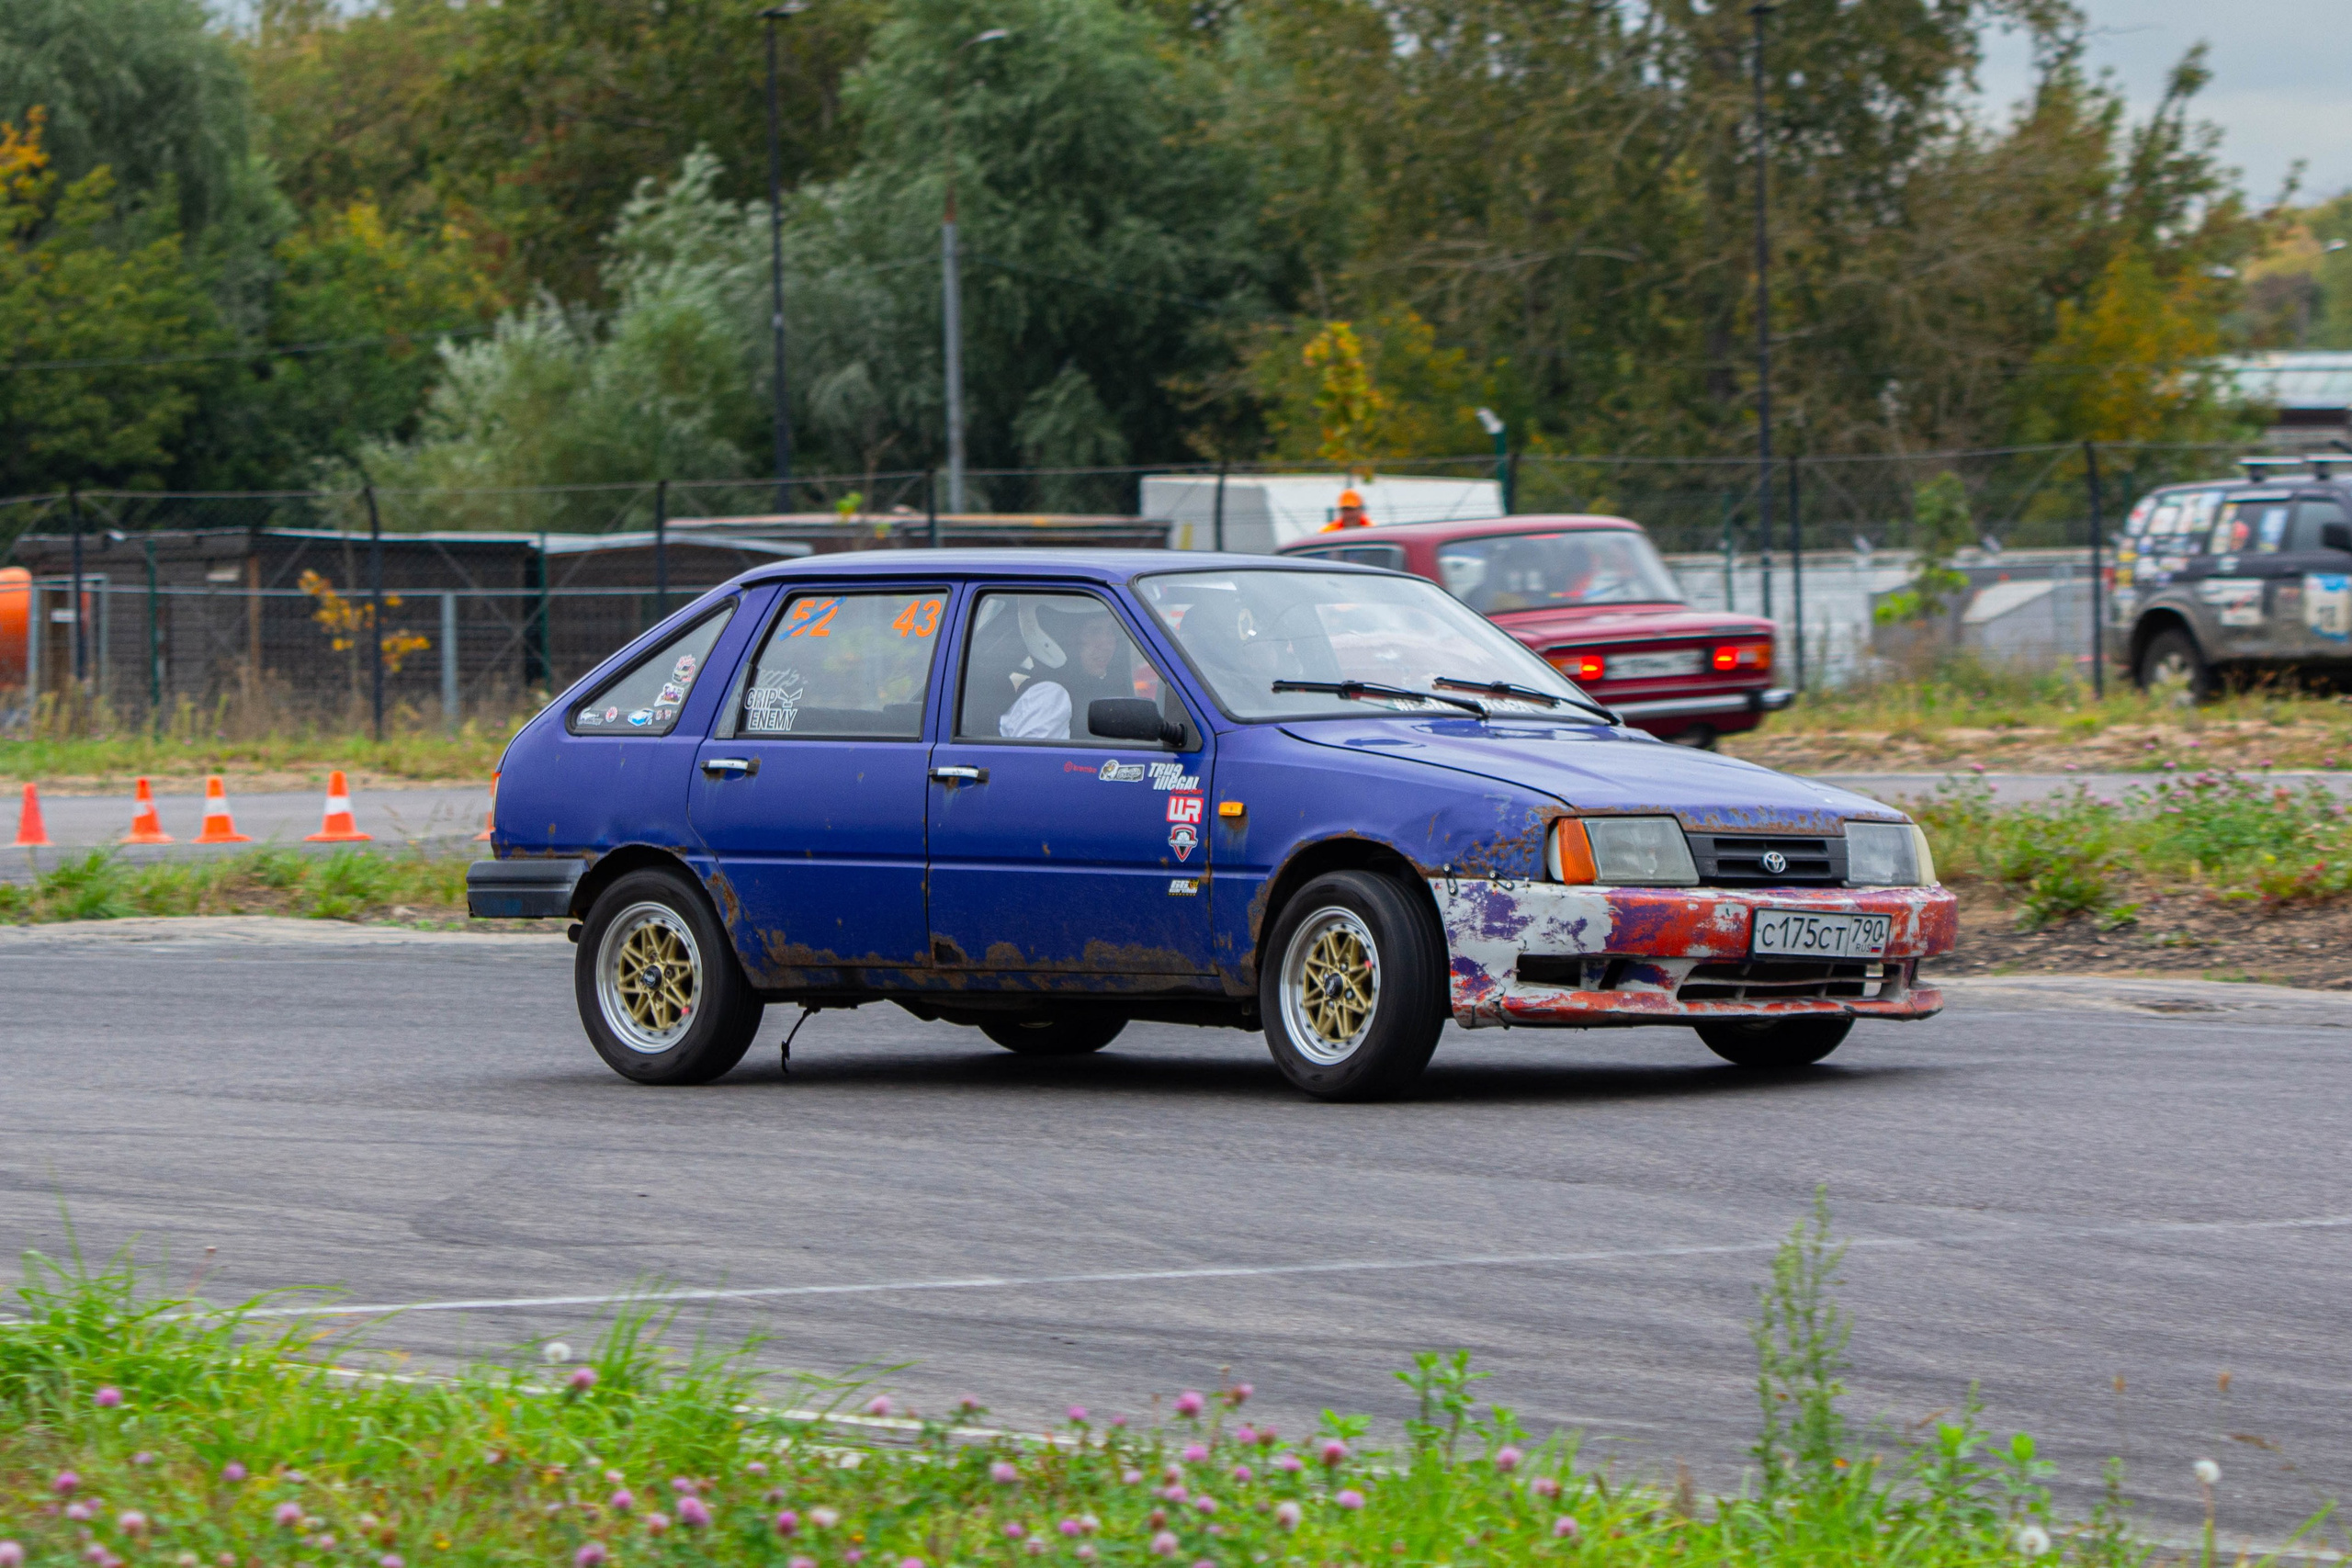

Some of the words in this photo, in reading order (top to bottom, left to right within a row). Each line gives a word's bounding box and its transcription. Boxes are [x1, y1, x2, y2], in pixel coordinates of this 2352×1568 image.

[787, 600, 839, 637] 52
[892, 599, 942, 637] 43
[744, 687, 778, 710] GRIP
[748, 708, 797, 731] ENEMY
[1851, 918, 1883, 943] 790
[1855, 942, 1871, 953] RUS
